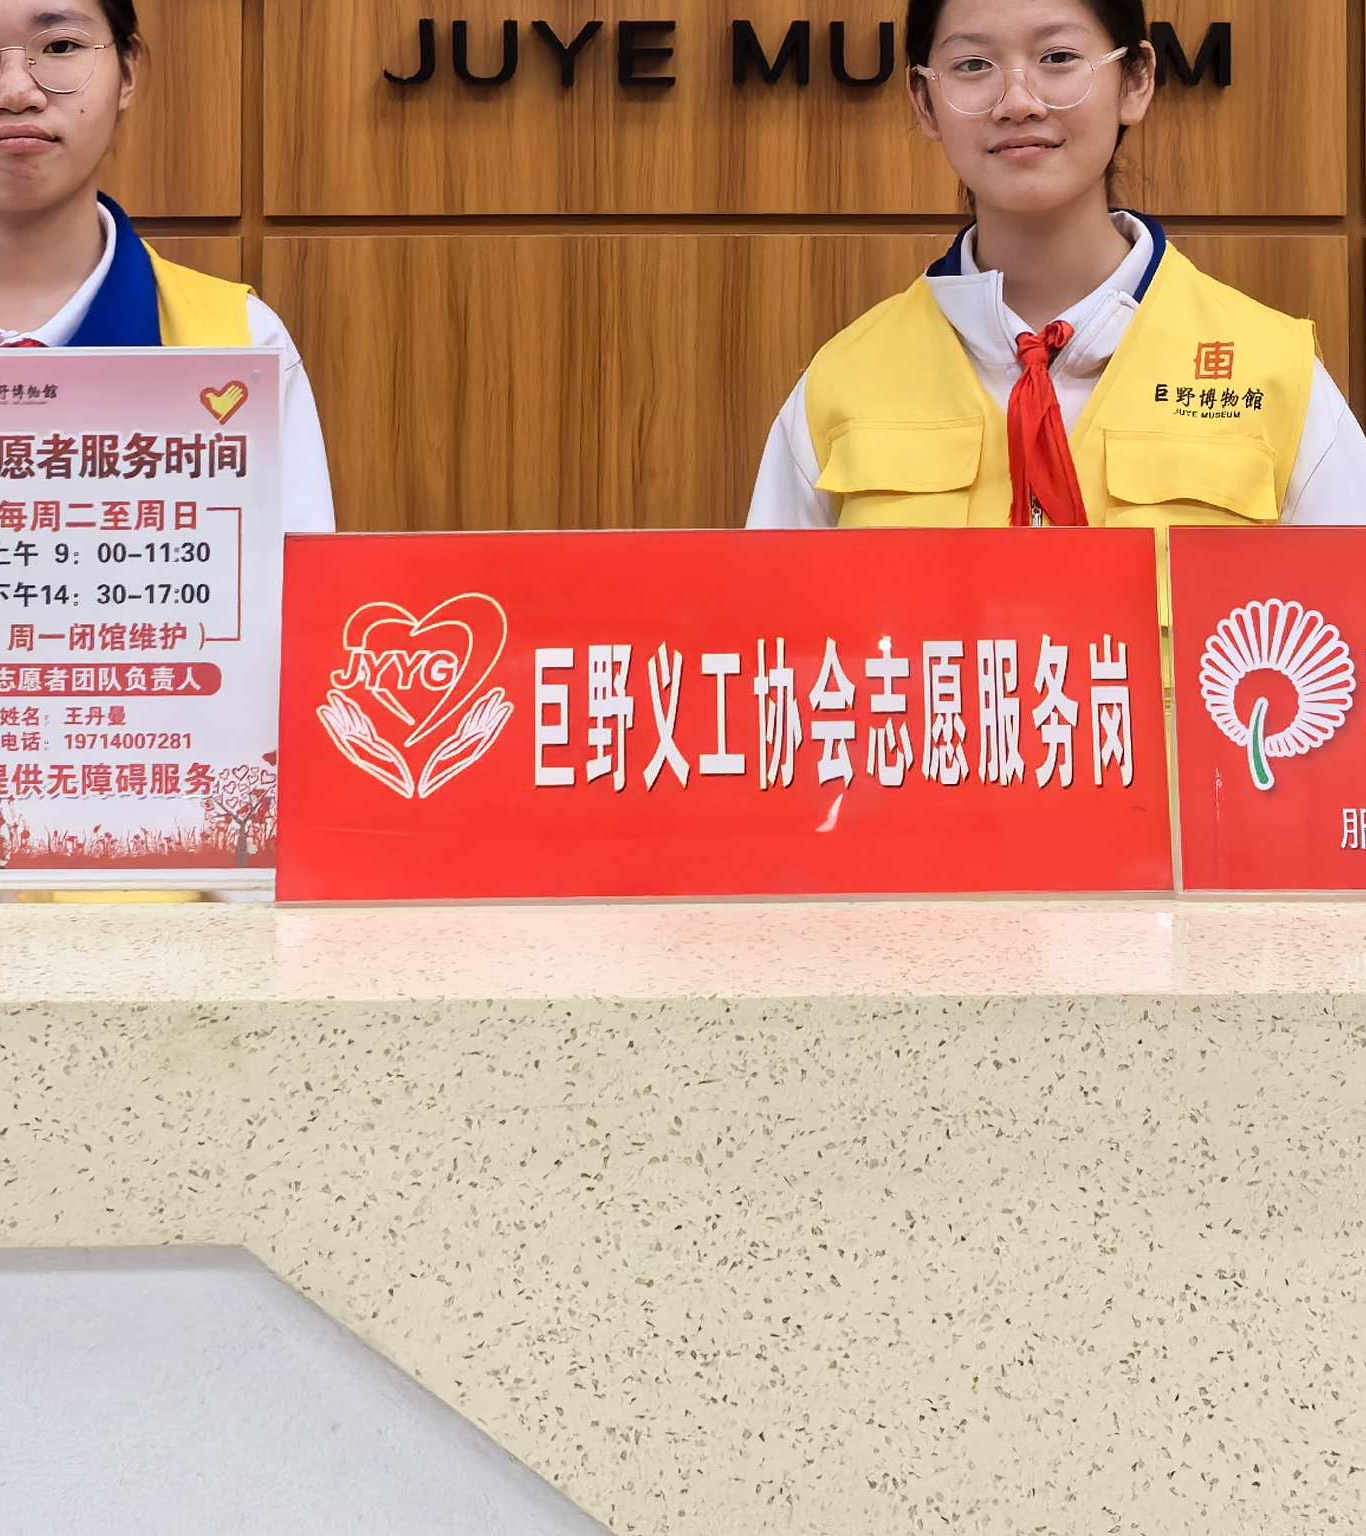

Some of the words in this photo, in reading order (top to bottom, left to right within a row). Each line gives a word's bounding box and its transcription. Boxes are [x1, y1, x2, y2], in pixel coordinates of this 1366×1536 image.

[383, 20, 676, 88] JUYE
[732, 20, 1233, 88] MUM
[1154, 383, 1265, 410] 巨野博物館
[1200, 410, 1242, 420] MUSEUM
[330, 648, 459, 692] JYYG
[532, 632, 1136, 792] 巨野义工协会志愿服务岗
